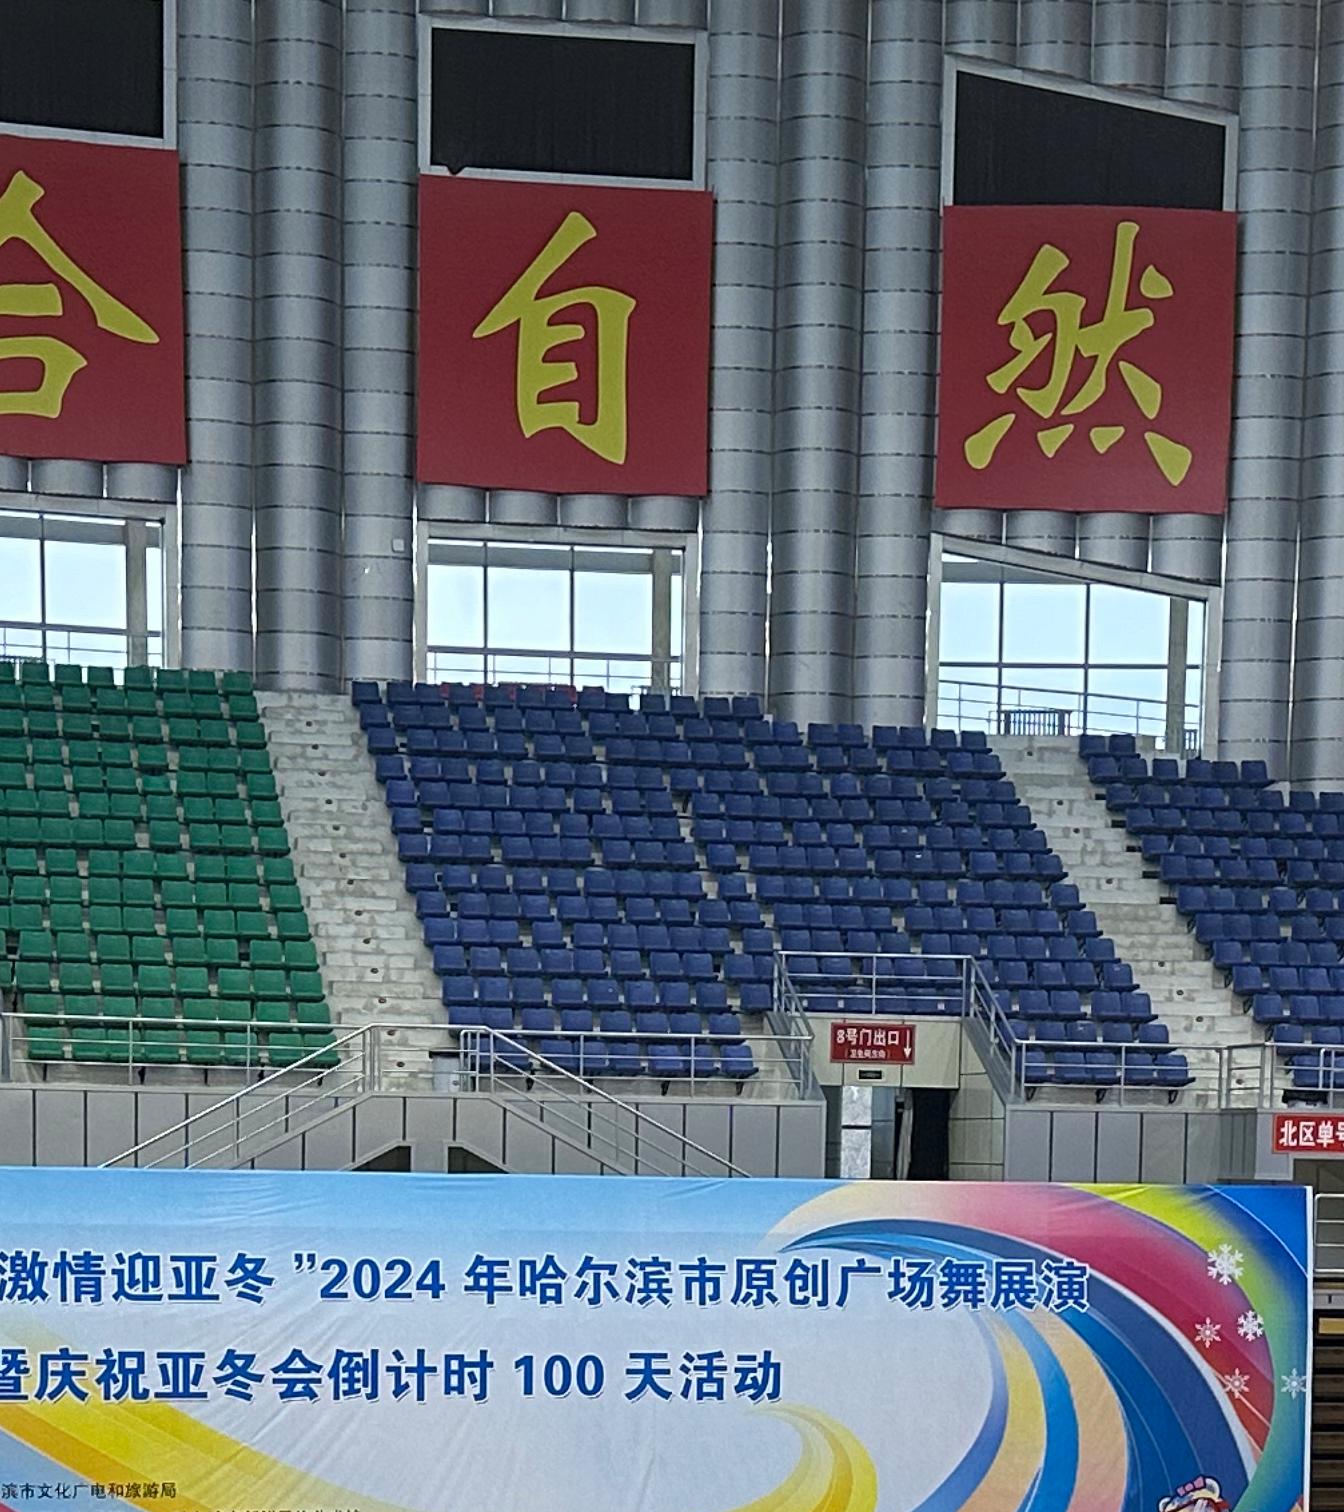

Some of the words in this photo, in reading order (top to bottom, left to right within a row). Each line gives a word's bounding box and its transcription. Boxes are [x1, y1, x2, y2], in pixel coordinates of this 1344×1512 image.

[471, 211, 637, 466] 自
[963, 220, 1193, 487] 然
[835, 1028, 900, 1046] 8号门出口
